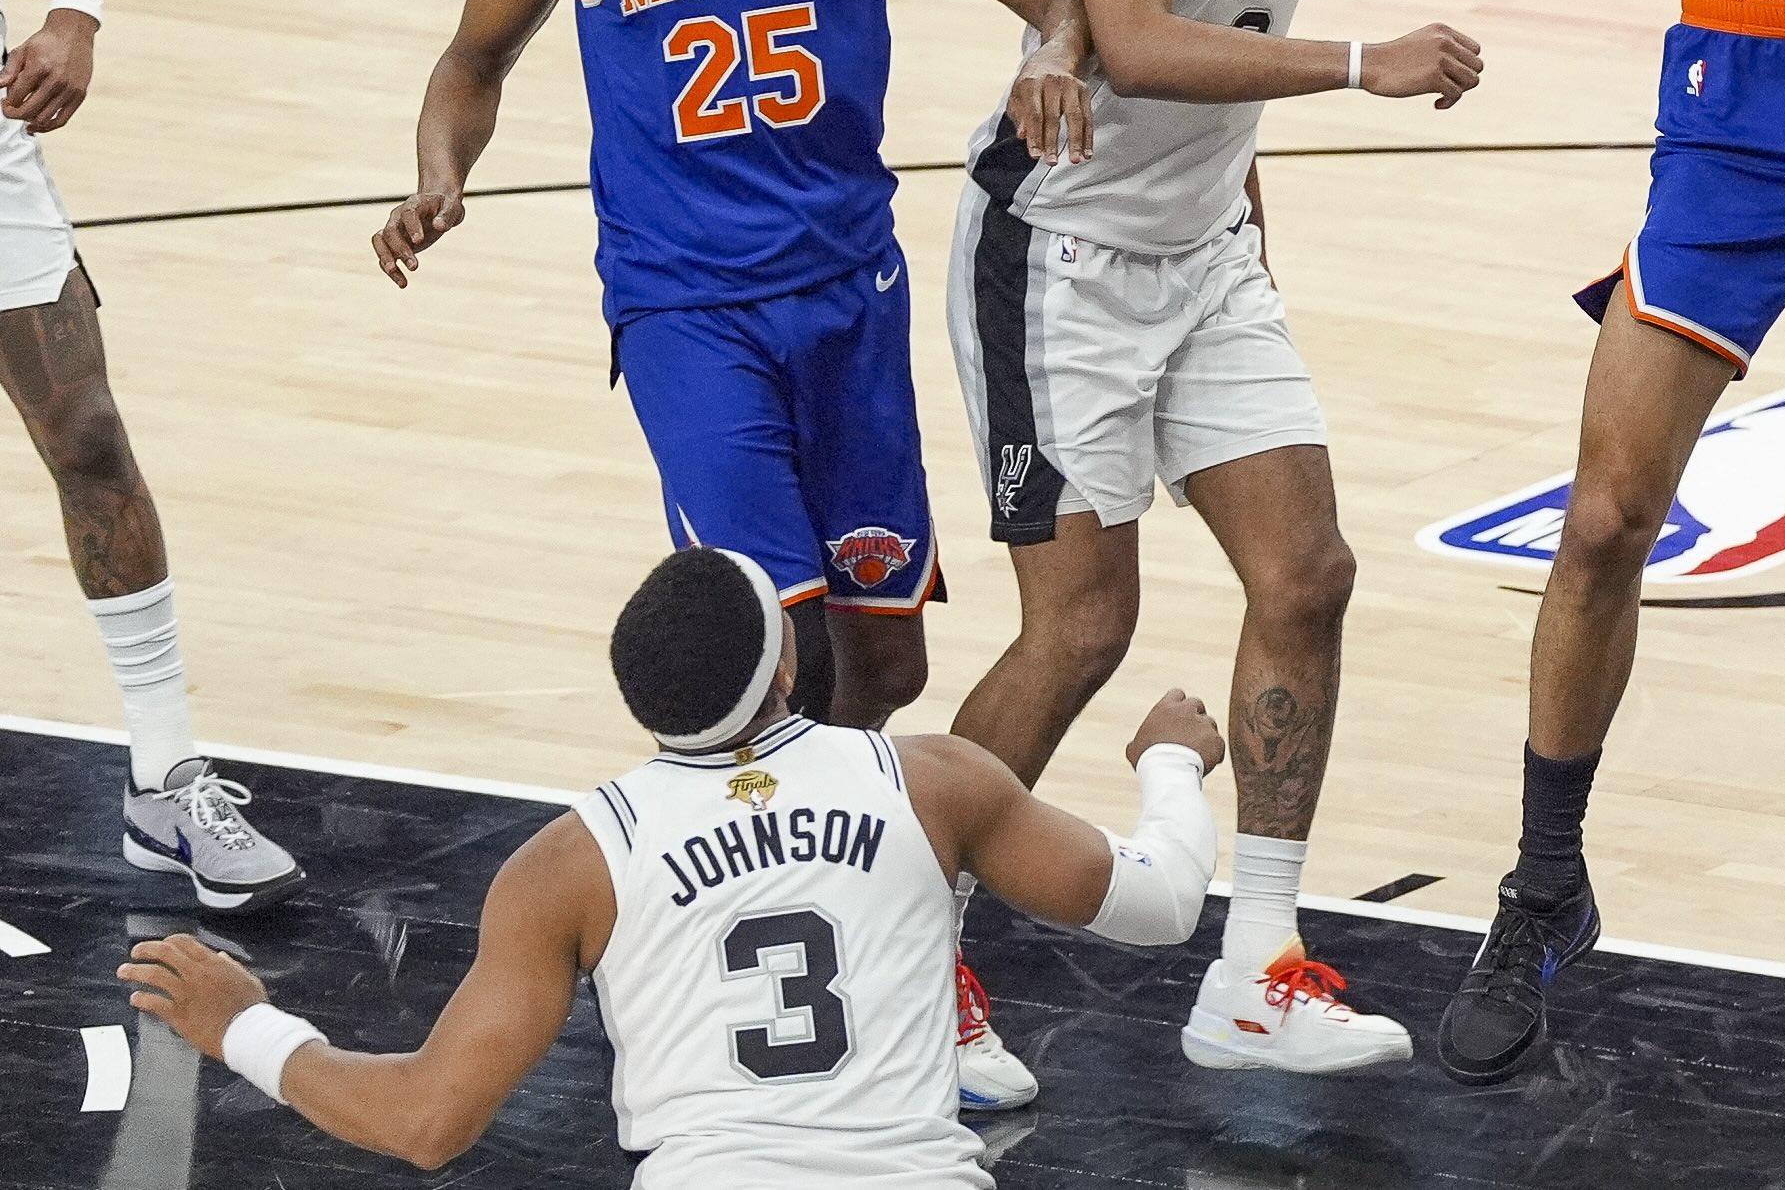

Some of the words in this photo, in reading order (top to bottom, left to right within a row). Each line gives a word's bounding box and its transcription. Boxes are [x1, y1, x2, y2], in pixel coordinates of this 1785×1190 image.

[662, 0, 826, 145] 25
[661, 807, 886, 908] JOHNSON
[716, 902, 858, 1087] 3
